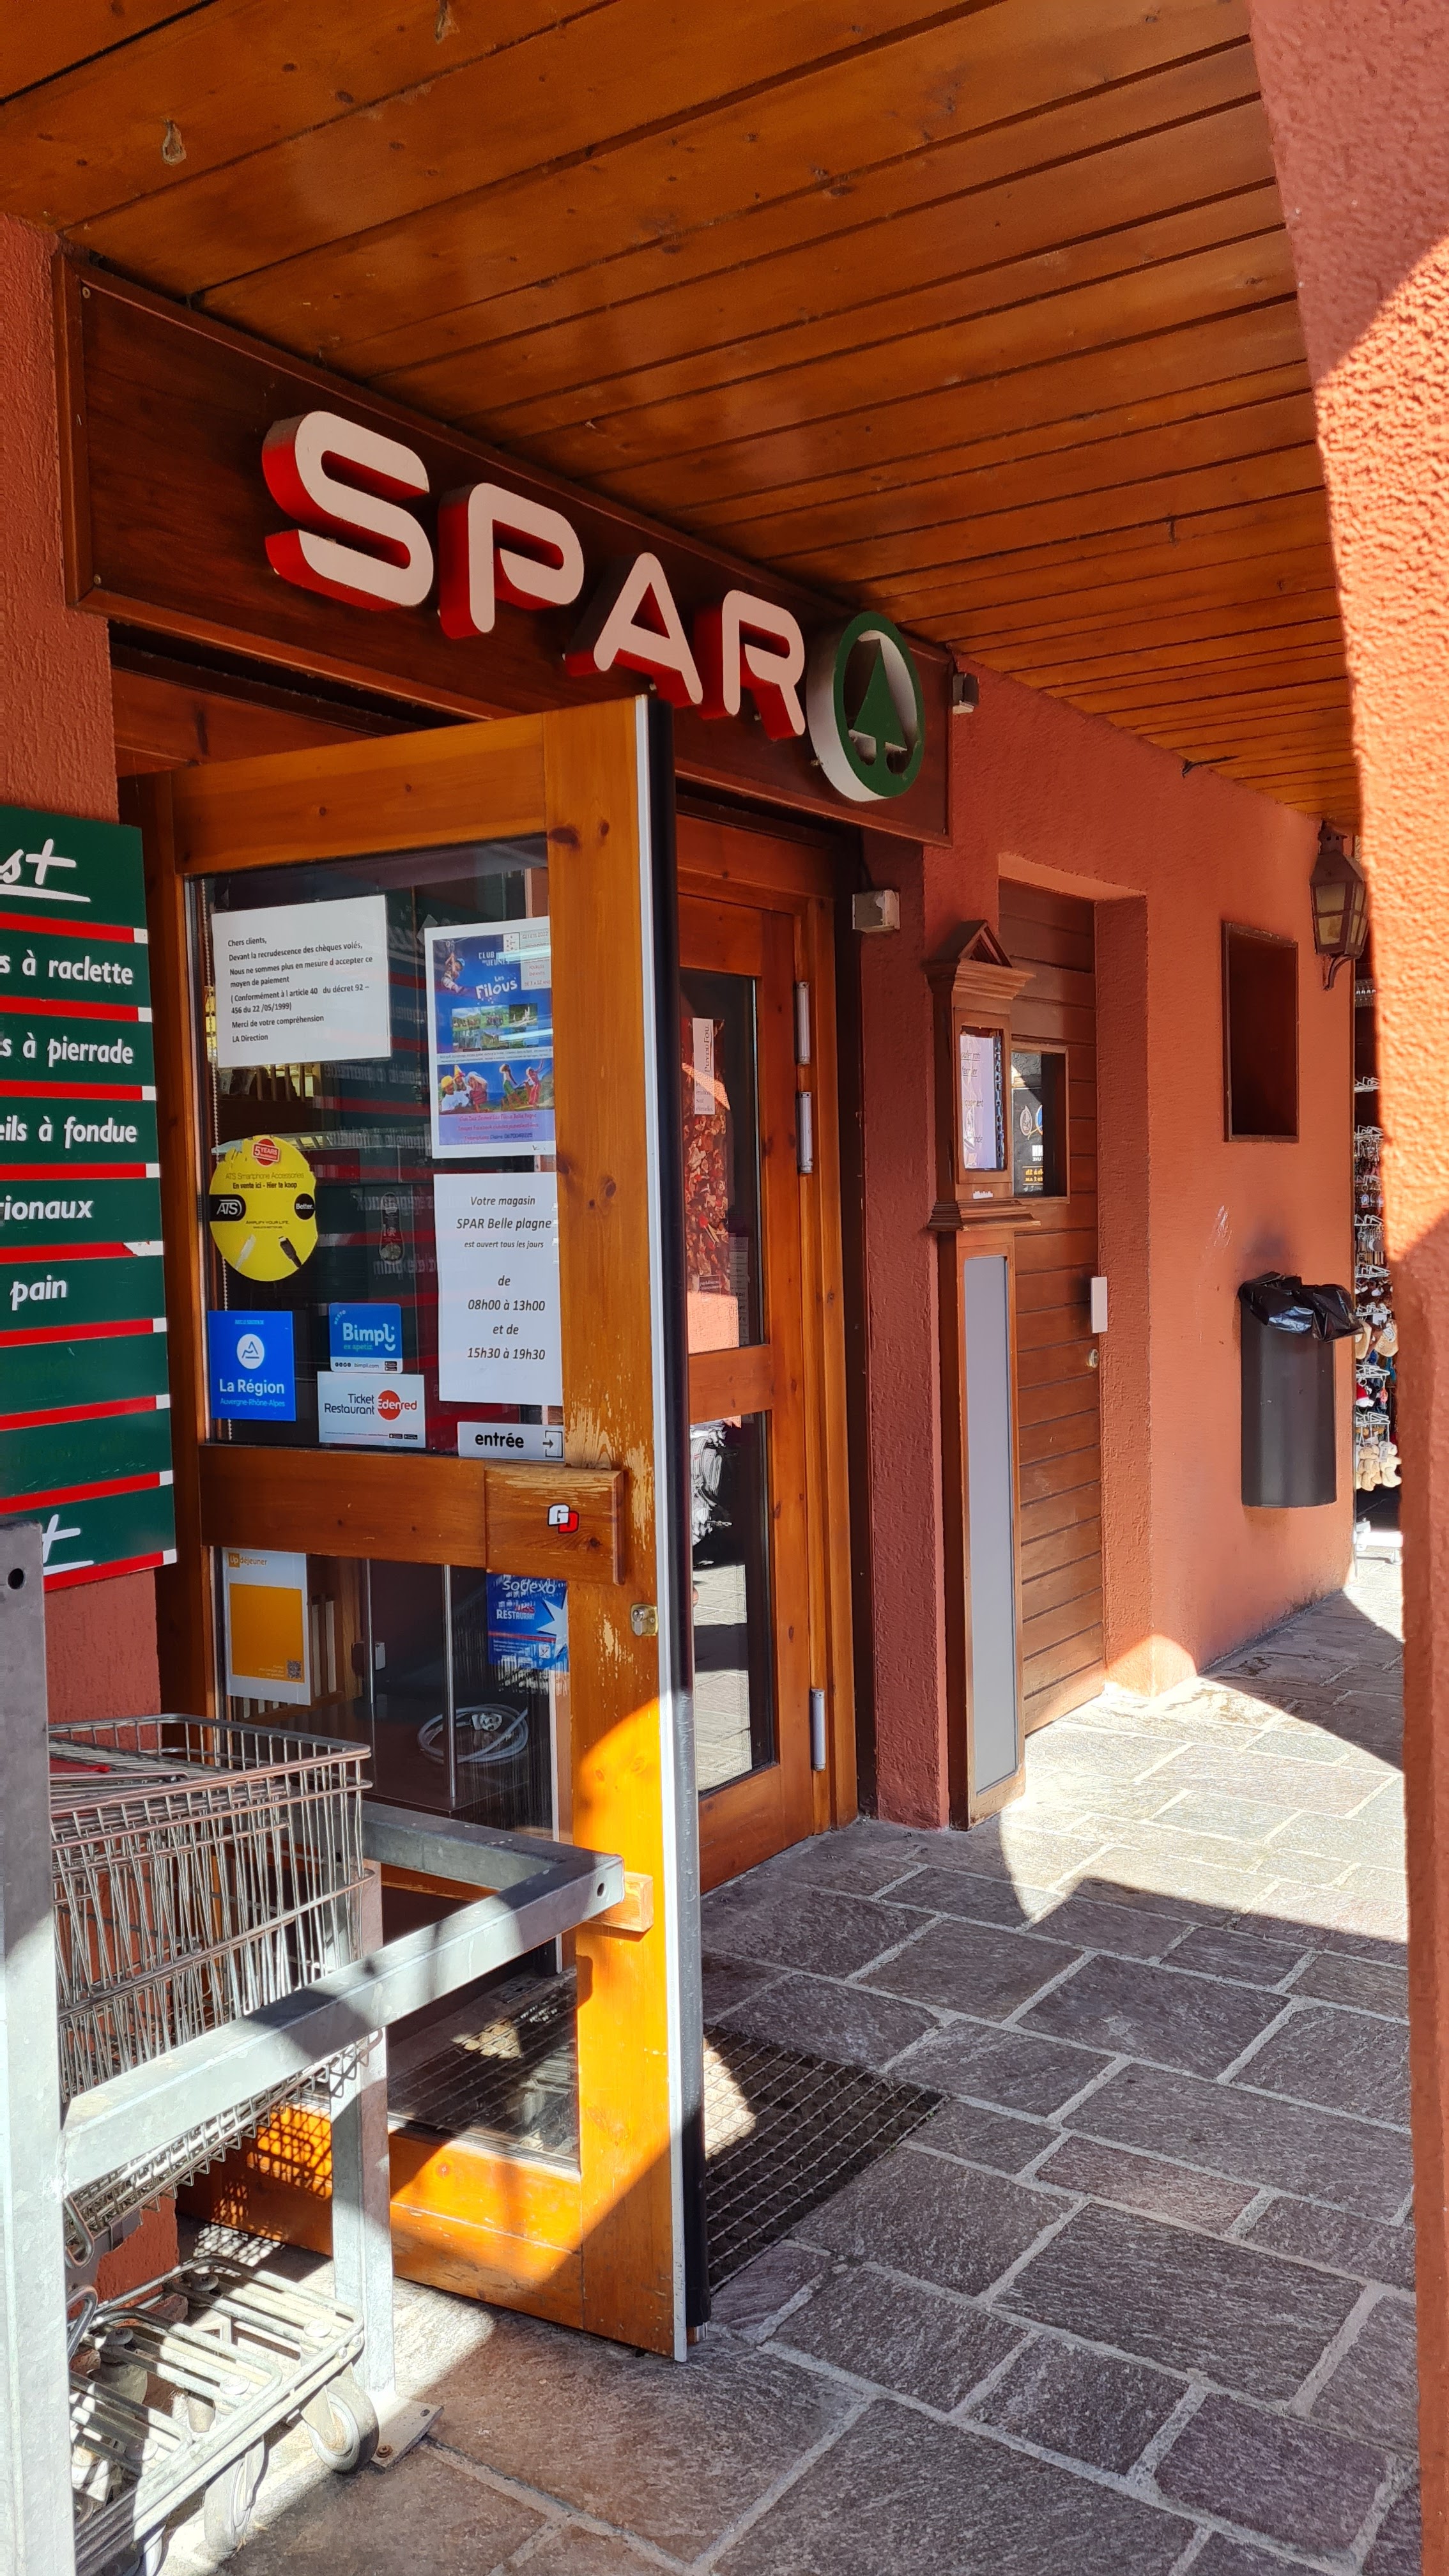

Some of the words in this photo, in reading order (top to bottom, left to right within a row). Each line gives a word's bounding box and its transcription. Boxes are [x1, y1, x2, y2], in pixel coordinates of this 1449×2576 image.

[263, 410, 805, 740] SPAR
[246, 937, 267, 945] clients,
[229, 953, 250, 962] Devant
[258, 947, 302, 958] recrudescence
[316, 943, 342, 954] chèques
[344, 941, 363, 949] volés,
[22, 949, 36, 976] à
[49, 956, 134, 985] raclette
[281, 963, 294, 972] plus
[305, 960, 328, 968] mesure
[335, 956, 364, 965] accepter
[261, 976, 289, 985] paiement
[234, 991, 279, 1002] Conformément
[289, 988, 309, 997] article
[333, 985, 353, 993] décret
[243, 1005, 251, 1013] du
[232, 1020, 249, 1029] Merci
[277, 1015, 324, 1025] compréhension
[241, 1033, 268, 1042] Direction
[23, 1032, 36, 1059] à
[48, 1037, 134, 1067] pierrade
[38, 1116, 53, 1142] à
[64, 1116, 138, 1148] fondue
[254, 1146, 261, 1156] 5
[0, 1195, 93, 1220] ionaux
[217, 1200, 240, 1216] ATS
[470, 1196, 496, 1206] Votre
[498, 1196, 535, 1208] magasin
[456, 1218, 484, 1229] SPAR
[487, 1218, 513, 1229] Belle
[516, 1218, 551, 1231] plagne
[526, 1241, 544, 1250] jours
[498, 1275, 510, 1286] de
[10, 1275, 67, 1311] pain
[468, 1299, 501, 1310] 08h00
[503, 1300, 510, 1310] à
[513, 1300, 546, 1311] 13h00
[342, 1322, 395, 1346] Bimpli
[493, 1324, 503, 1335] et
[506, 1324, 519, 1335] de
[467, 1347, 500, 1359] 15h30
[503, 1348, 509, 1359] à
[512, 1349, 546, 1360] 19h30
[219, 1379, 234, 1393] La
[237, 1379, 285, 1397] Région
[348, 1393, 374, 1405] Ticket
[378, 1399, 417, 1411] Edenred
[325, 1403, 375, 1415] Restaurant
[475, 1432, 524, 1448] entrée
[240, 1556, 267, 1566] déjeuner
